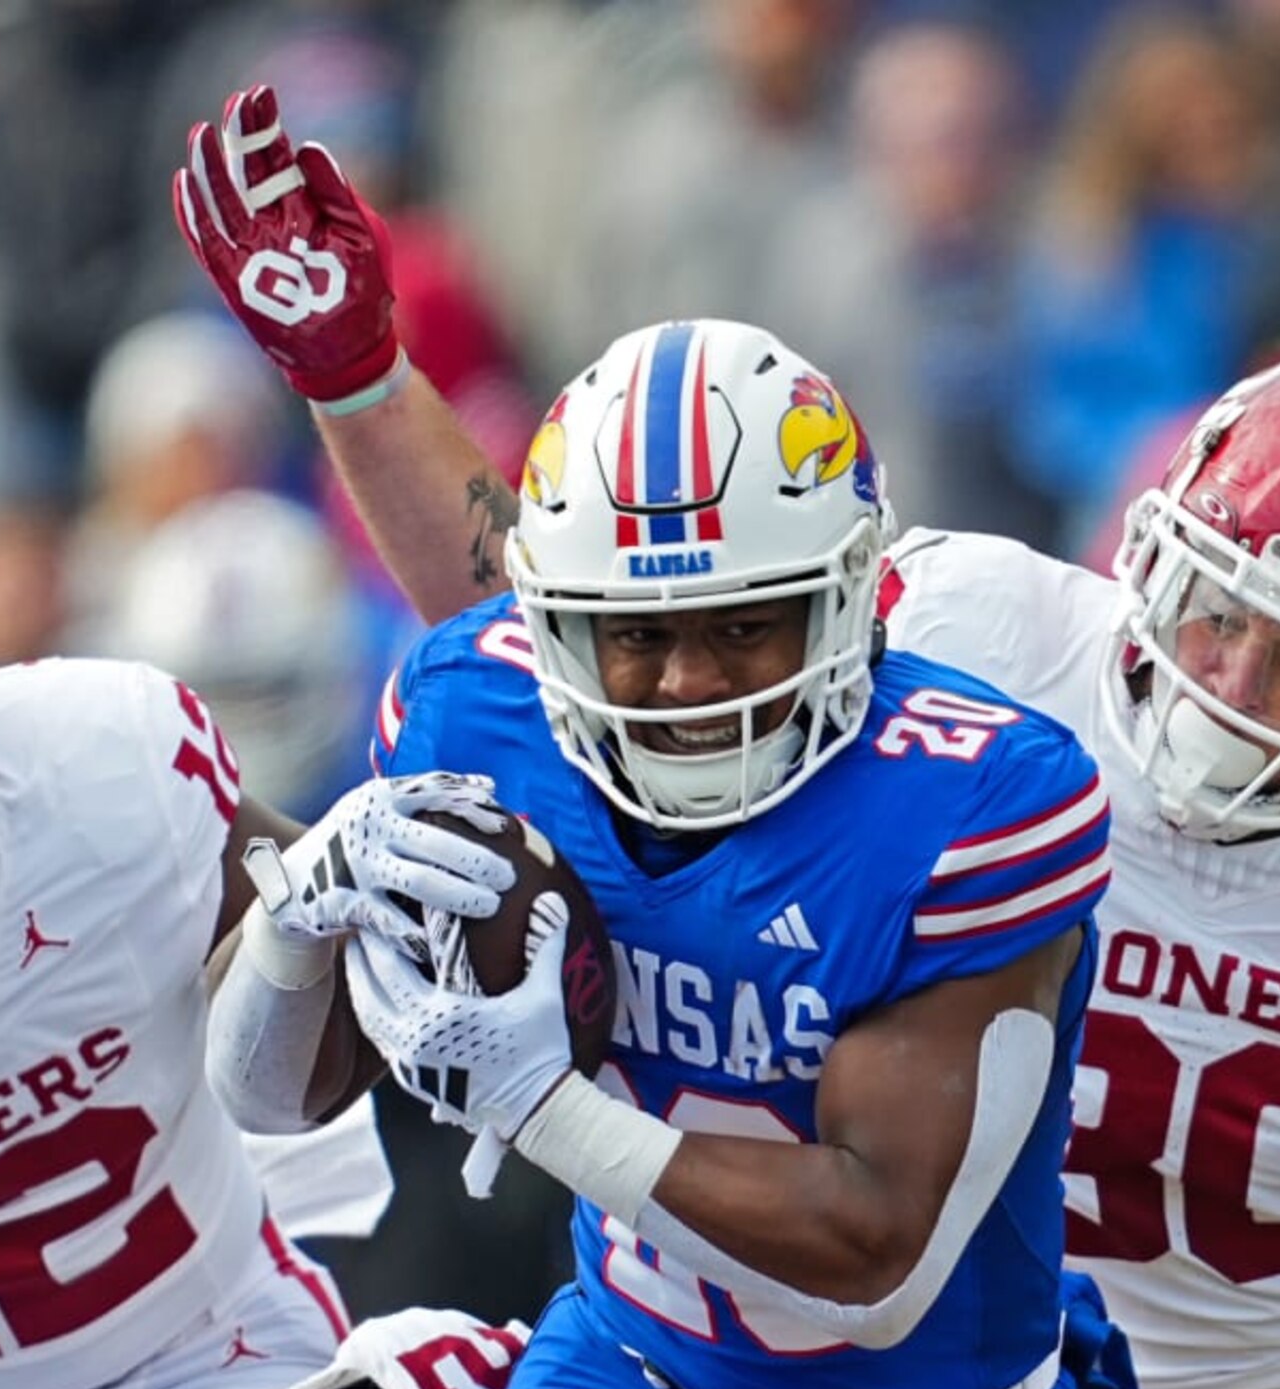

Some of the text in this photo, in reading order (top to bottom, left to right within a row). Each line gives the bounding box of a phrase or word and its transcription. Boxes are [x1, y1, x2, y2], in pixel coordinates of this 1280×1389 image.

[628, 550, 712, 578] KANSAS
[873, 686, 1025, 765] 20
[609, 938, 834, 1084] NSAS
